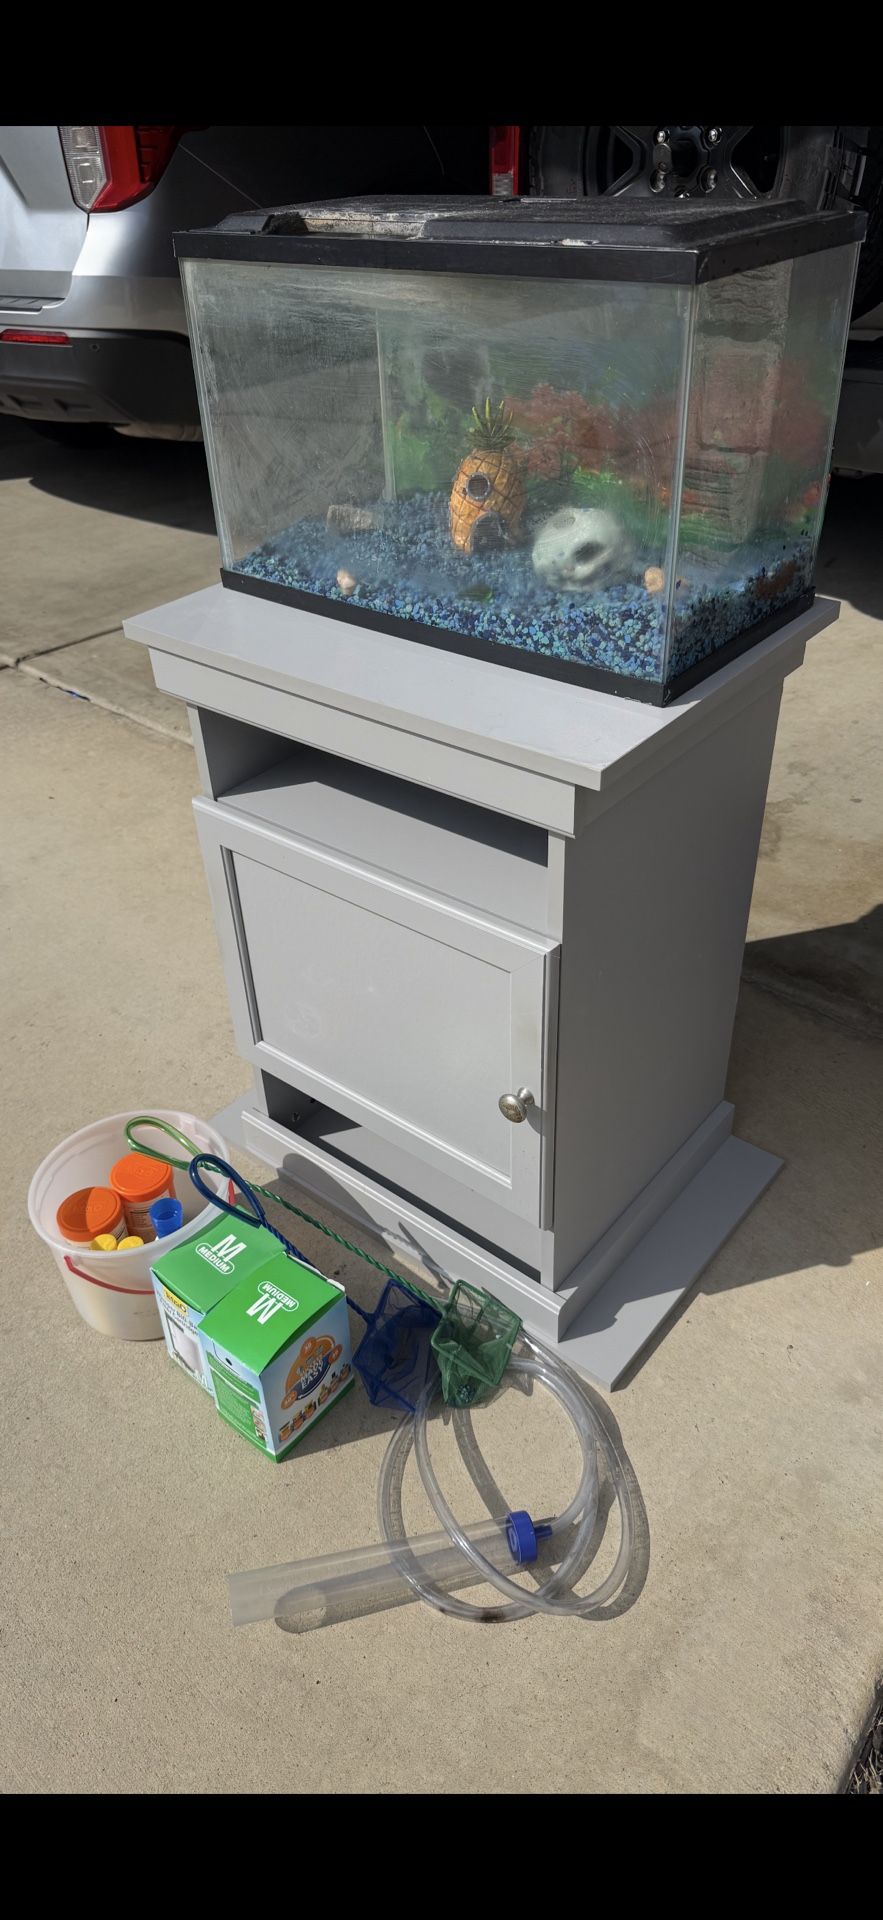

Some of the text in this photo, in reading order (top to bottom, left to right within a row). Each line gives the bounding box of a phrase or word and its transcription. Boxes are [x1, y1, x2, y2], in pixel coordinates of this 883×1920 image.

[198, 1246, 231, 1273] MEDIUM
[210, 1234, 248, 1263] M
[246, 1292, 284, 1325] M
[261, 1282, 296, 1308] MEDIUM
[300, 1364, 323, 1390] EASY
